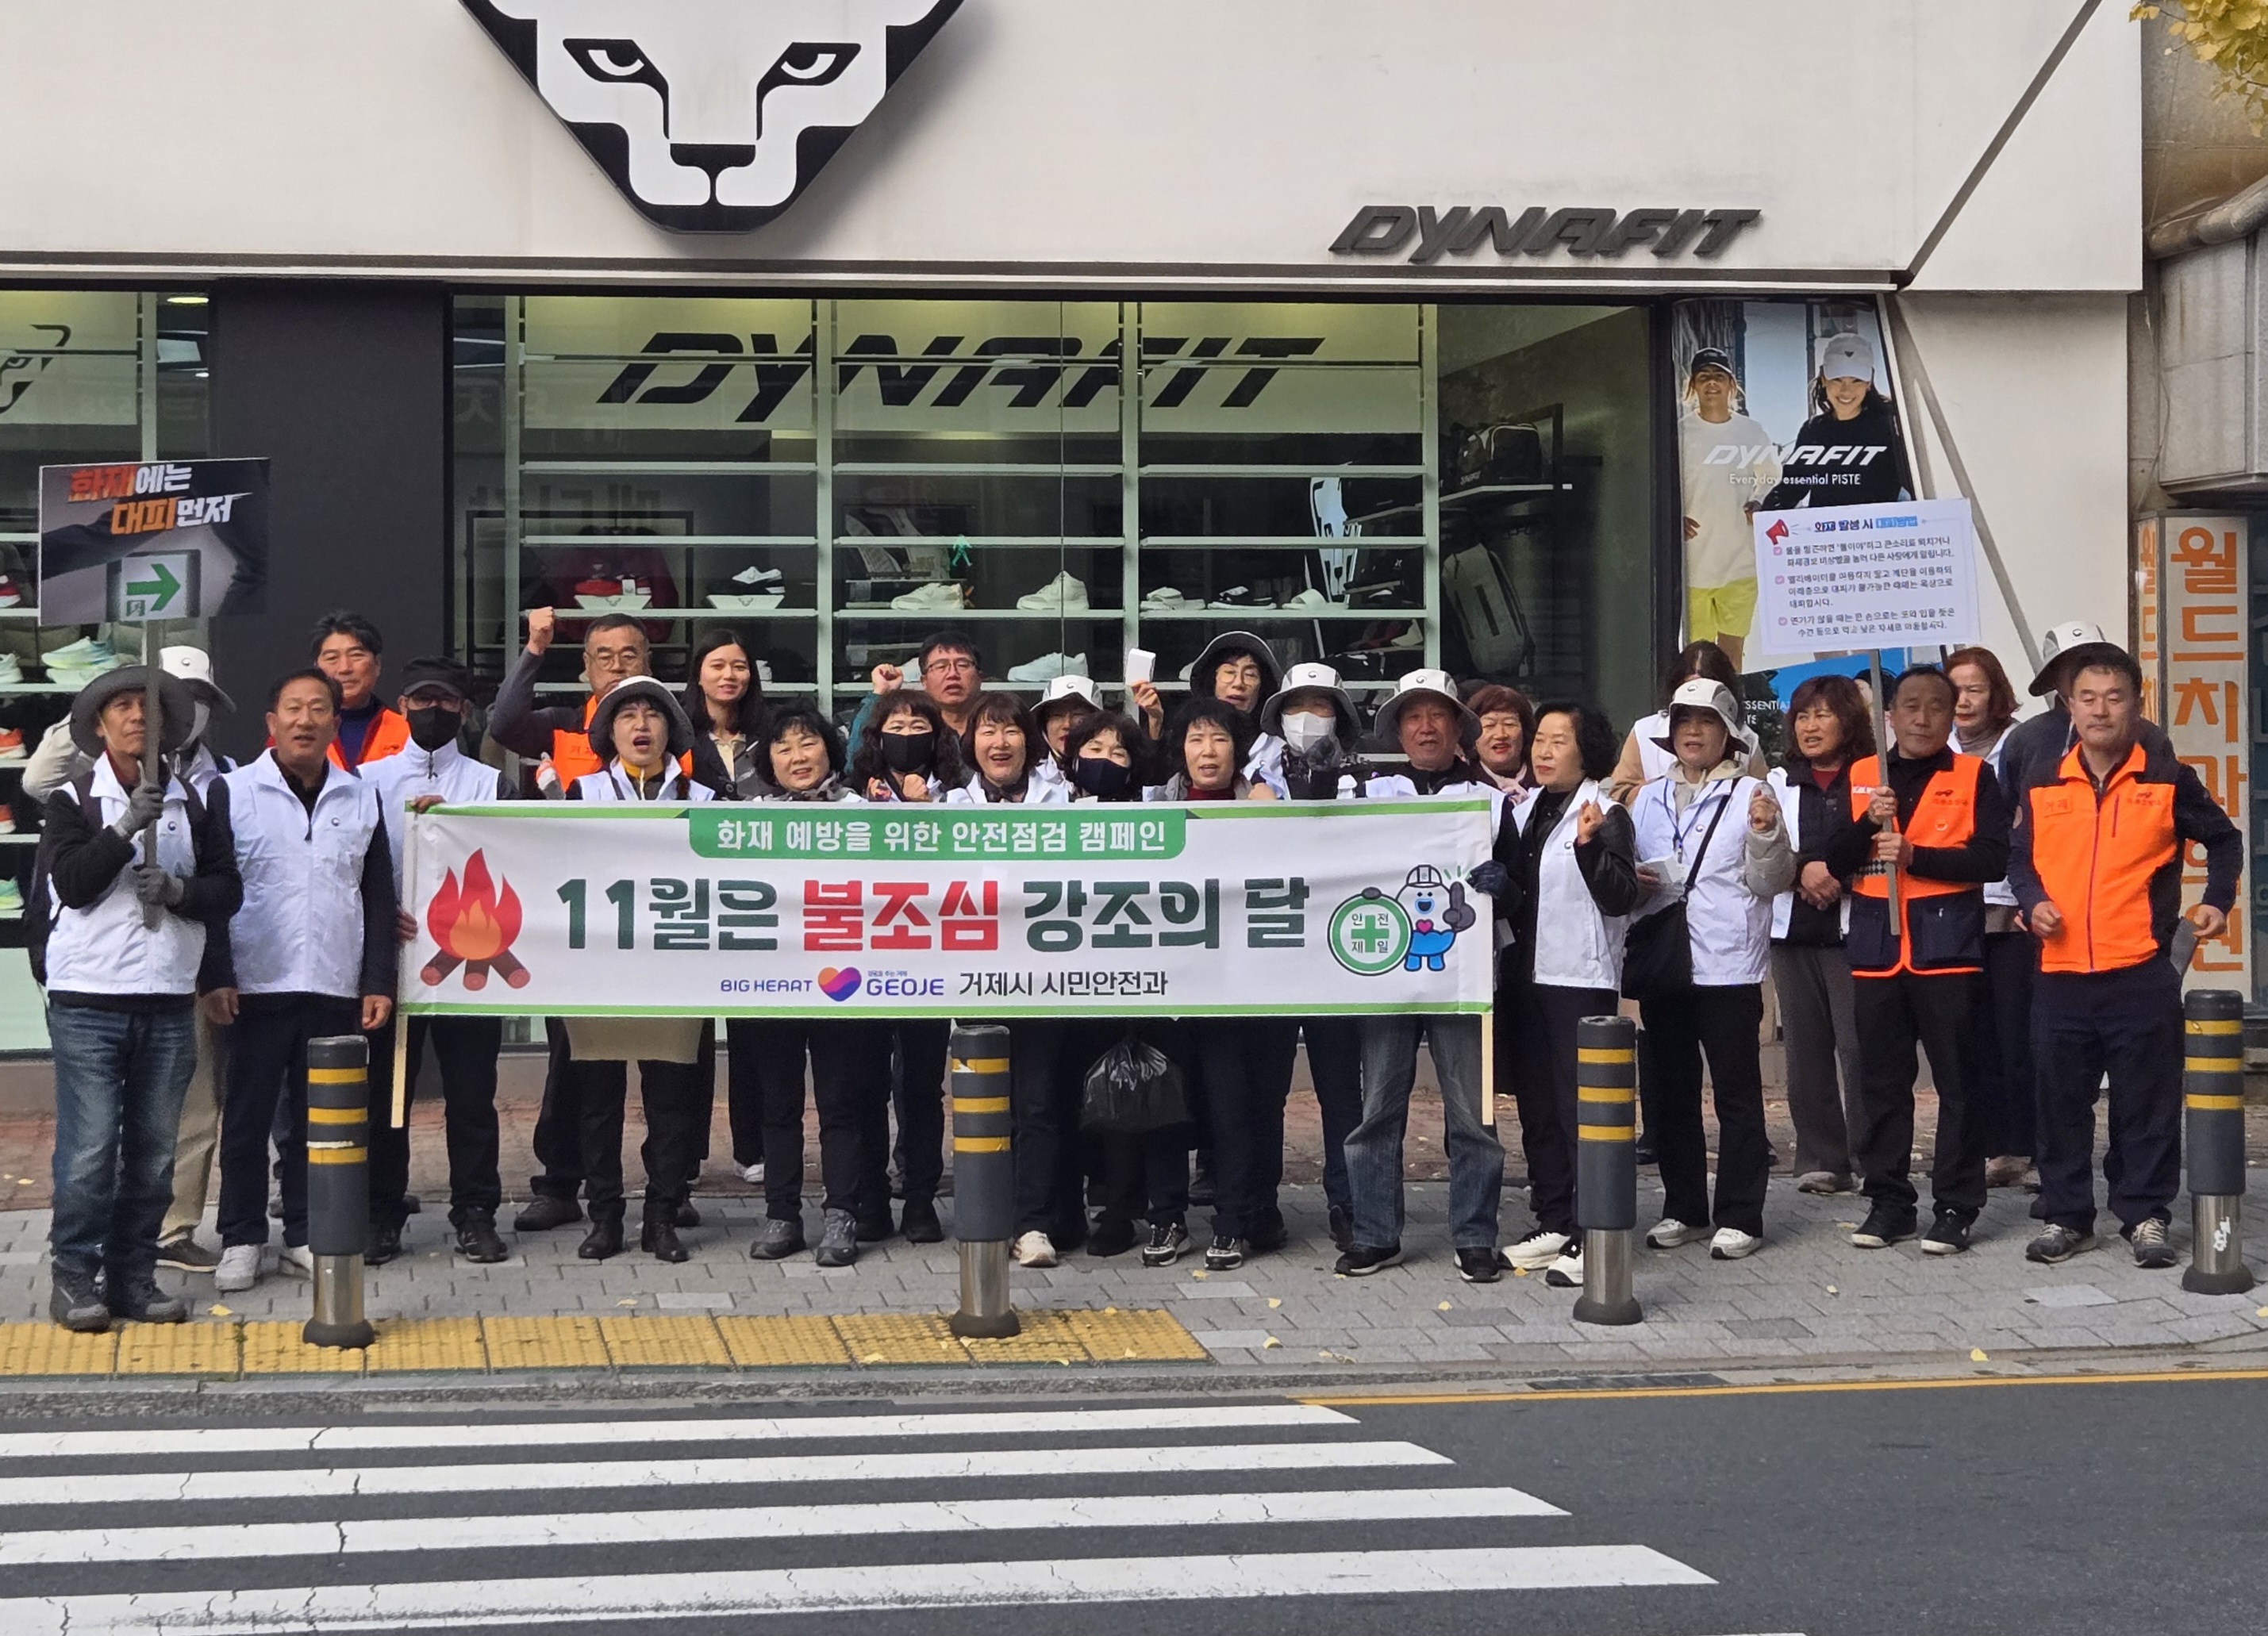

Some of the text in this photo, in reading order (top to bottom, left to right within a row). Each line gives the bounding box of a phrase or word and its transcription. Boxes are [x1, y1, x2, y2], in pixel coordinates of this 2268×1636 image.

[1328, 205, 1761, 263] DYNAFIT
[596, 332, 1324, 423] DYNAFIT
[1702, 445, 1888, 469] DYNAFIT
[1783, 473, 1829, 485] essential
[1832, 473, 1861, 485] PISTE
[1861, 518, 1873, 529] 시
[717, 820, 1166, 852] 화재 예방을 위한 안전점검 캠페인
[557, 878, 1310, 952] 11월은 불조심 강조의 달
[721, 980, 813, 993] BIG HEART
[866, 977, 944, 997] GEOJE
[959, 971, 1168, 997] 거제시 시민안전과
